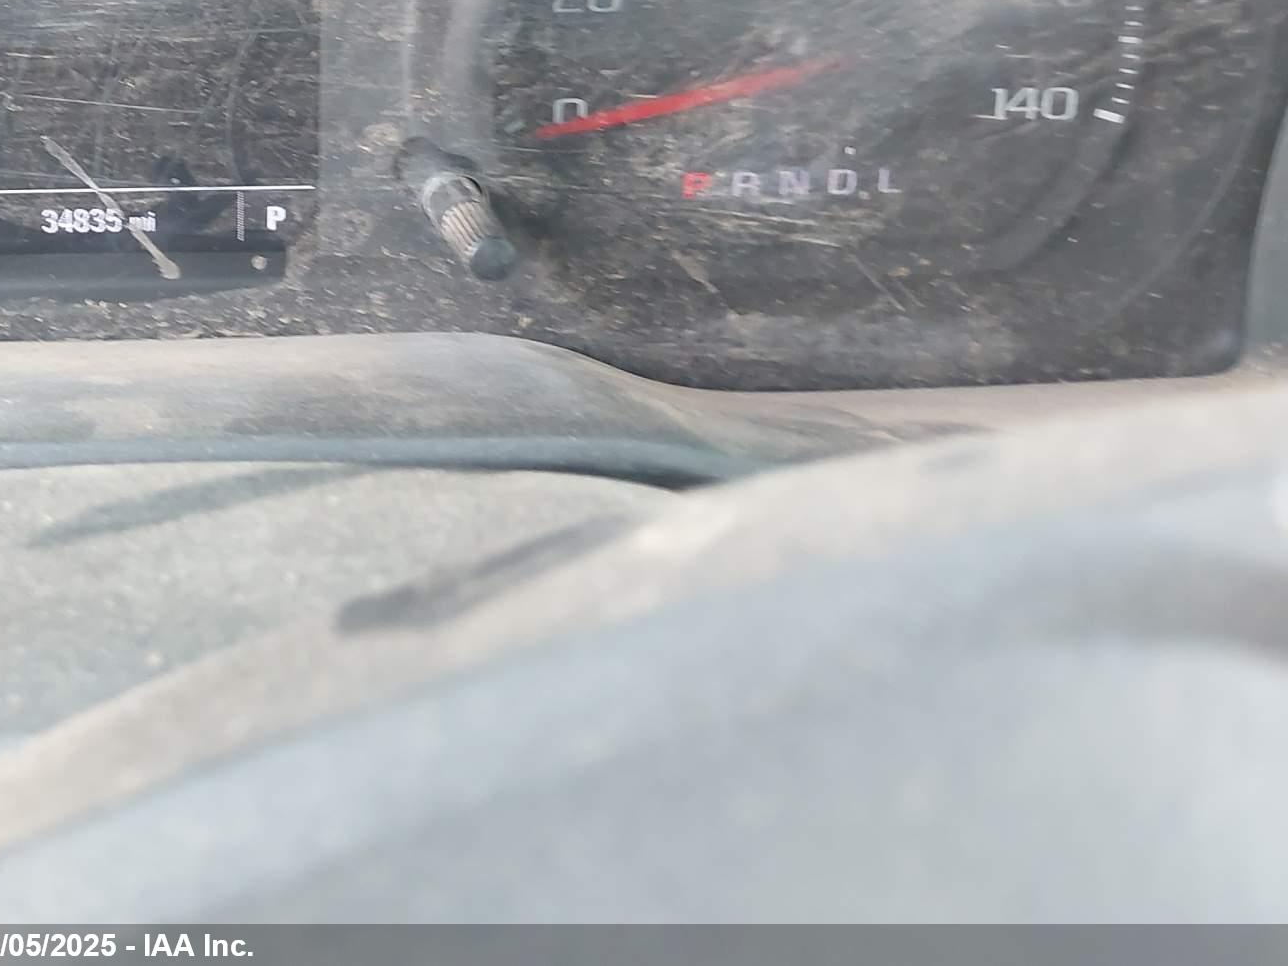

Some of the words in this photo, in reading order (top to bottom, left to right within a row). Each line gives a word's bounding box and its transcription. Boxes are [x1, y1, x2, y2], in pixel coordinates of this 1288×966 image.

[990, 86, 1079, 120] 140
[731, 170, 762, 197] R
[778, 169, 811, 196] N
[827, 168, 858, 195] D
[878, 167, 903, 194] L
[40, 208, 123, 234] 34835
[129, 211, 157, 233] mi
[265, 205, 287, 231] P
